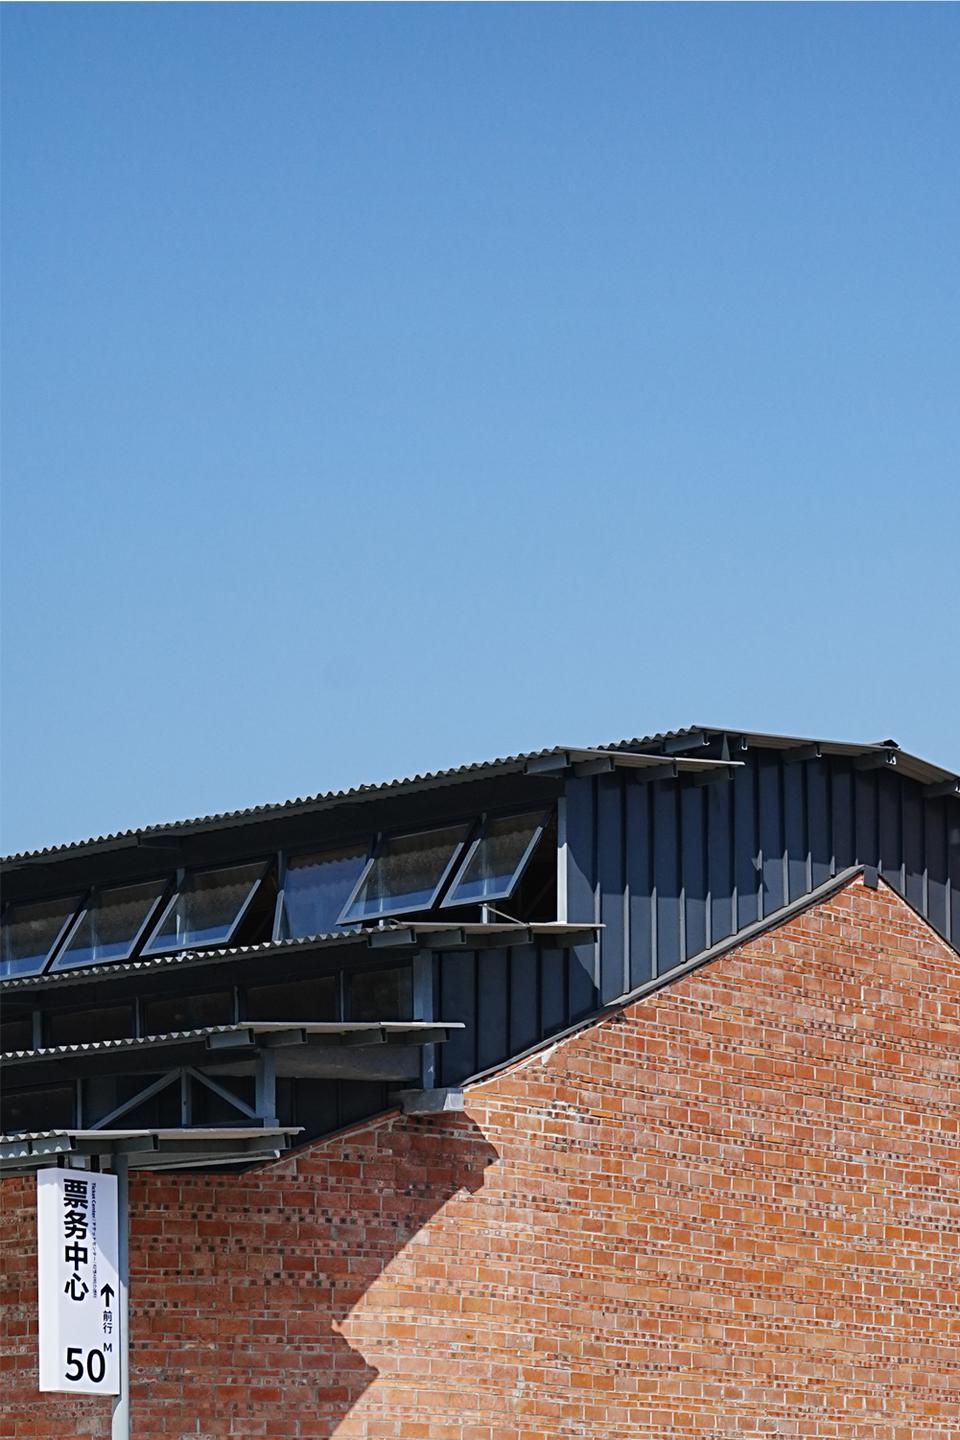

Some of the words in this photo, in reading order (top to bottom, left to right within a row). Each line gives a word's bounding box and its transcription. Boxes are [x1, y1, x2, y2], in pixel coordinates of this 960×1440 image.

[63, 1178, 89, 1302] 票务中心
[103, 1310, 112, 1334] 前行
[65, 1347, 105, 1383] 50
[103, 1342, 112, 1353] M
